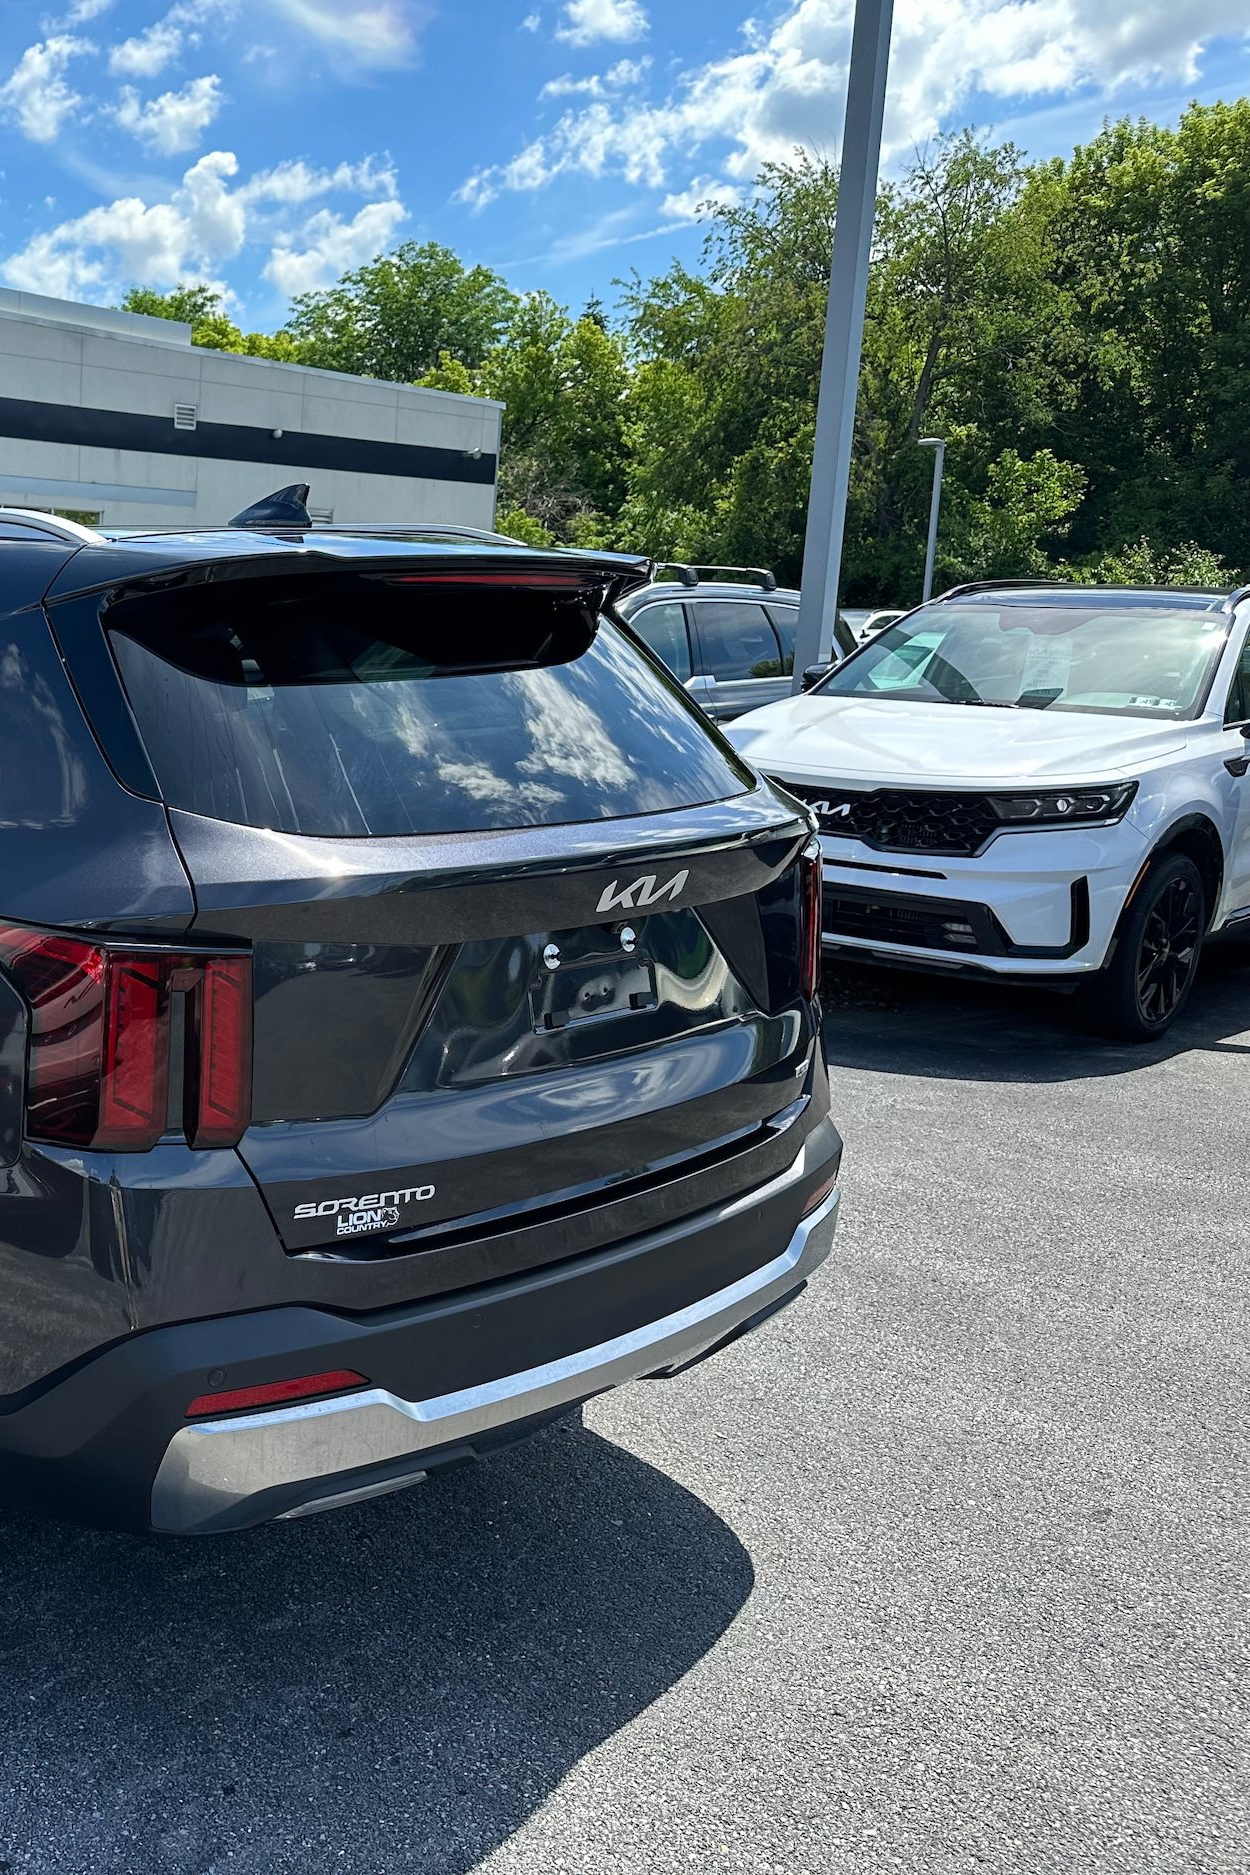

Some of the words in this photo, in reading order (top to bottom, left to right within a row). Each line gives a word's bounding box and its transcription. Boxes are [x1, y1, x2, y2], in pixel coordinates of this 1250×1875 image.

[596, 869, 690, 913] KIA
[293, 1184, 436, 1219] SORENTO
[336, 1208, 383, 1228] LION
[336, 1220, 388, 1236] COUNTRY
